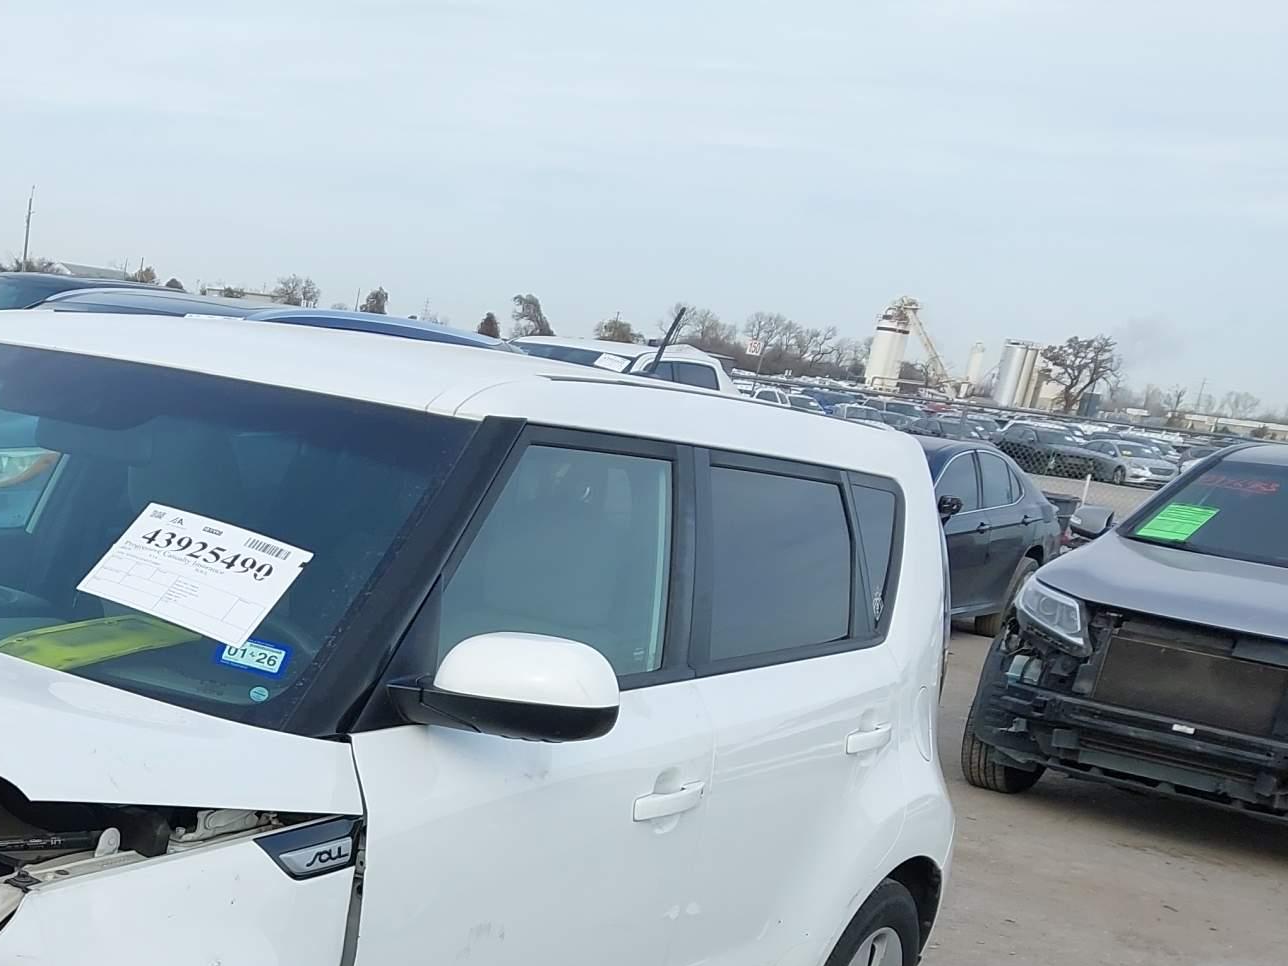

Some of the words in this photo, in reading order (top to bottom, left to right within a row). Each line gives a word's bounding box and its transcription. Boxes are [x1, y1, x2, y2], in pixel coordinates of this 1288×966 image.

[748, 341, 761, 354] 150
[142, 528, 274, 581] 43925490
[255, 652, 279, 667] 26
